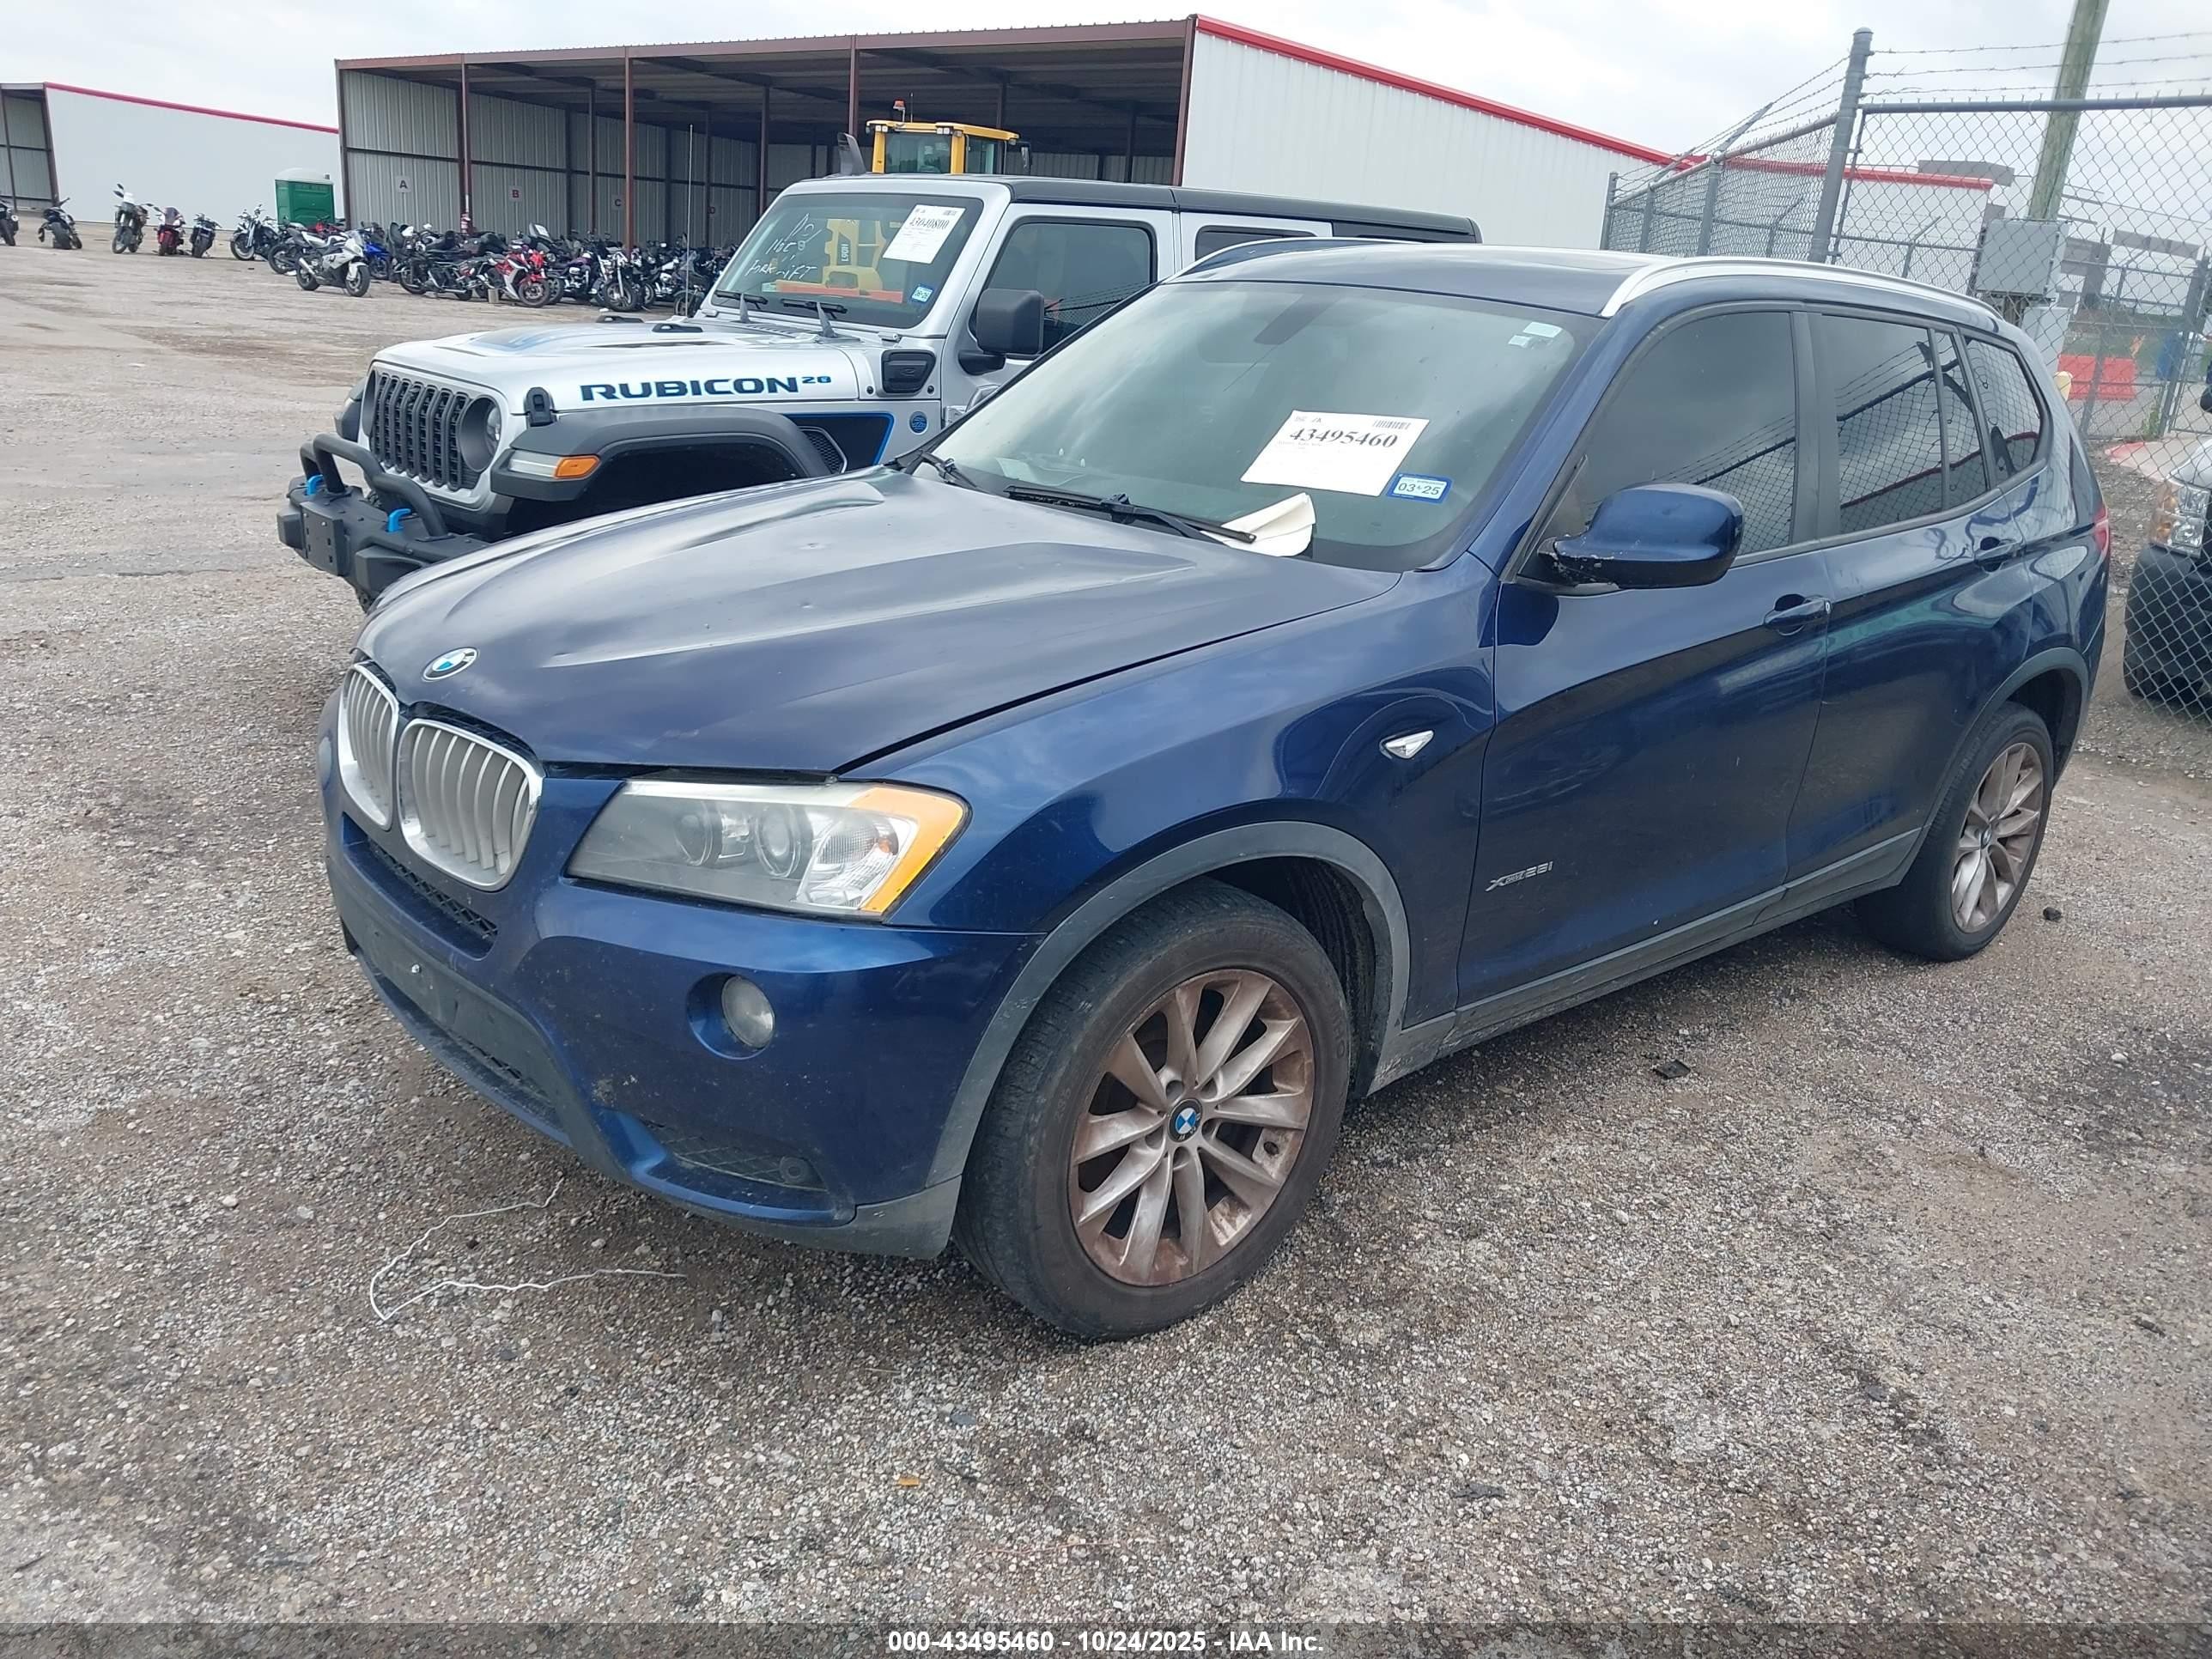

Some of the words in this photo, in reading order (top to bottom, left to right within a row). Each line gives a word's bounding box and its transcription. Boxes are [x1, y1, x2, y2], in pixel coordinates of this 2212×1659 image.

[399, 179, 408, 189] A
[512, 189, 520, 198] B
[614, 198, 622, 207] C
[579, 376, 799, 402] RUBICON
[1289, 428, 1399, 448] 43495460
